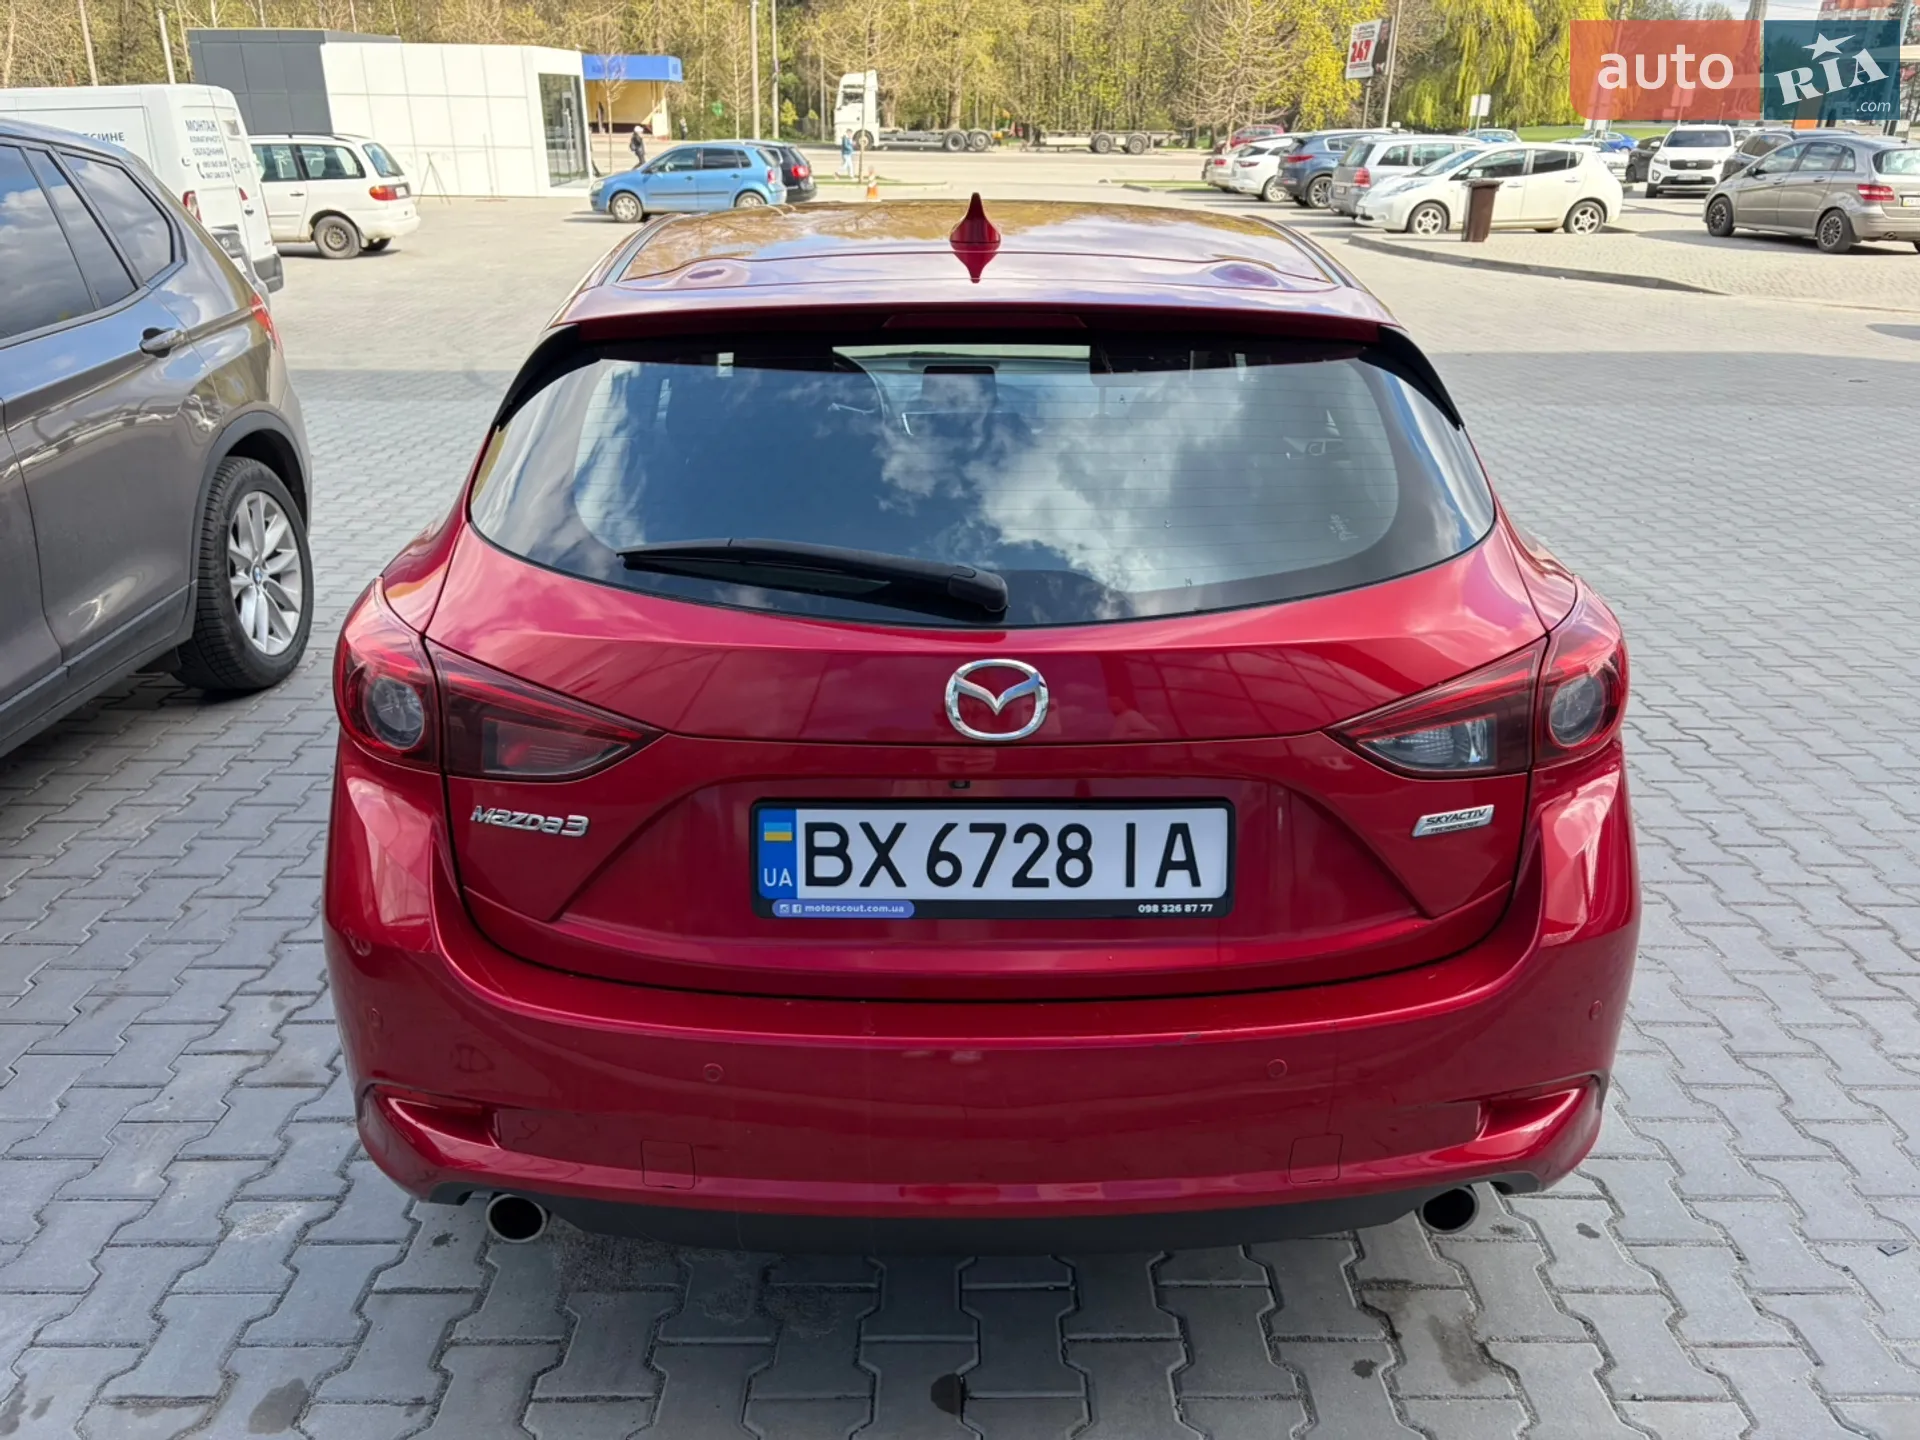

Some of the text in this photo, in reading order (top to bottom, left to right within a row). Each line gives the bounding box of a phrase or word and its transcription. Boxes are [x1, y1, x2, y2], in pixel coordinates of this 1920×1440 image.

[1426, 808, 1487, 825] SKYACTIV
[804, 821, 1202, 888] BX 6728 IA
[764, 868, 792, 887] UA
[805, 904, 904, 913] motorscout.com.ua
[1138, 904, 1213, 913] 098 326 87 77
